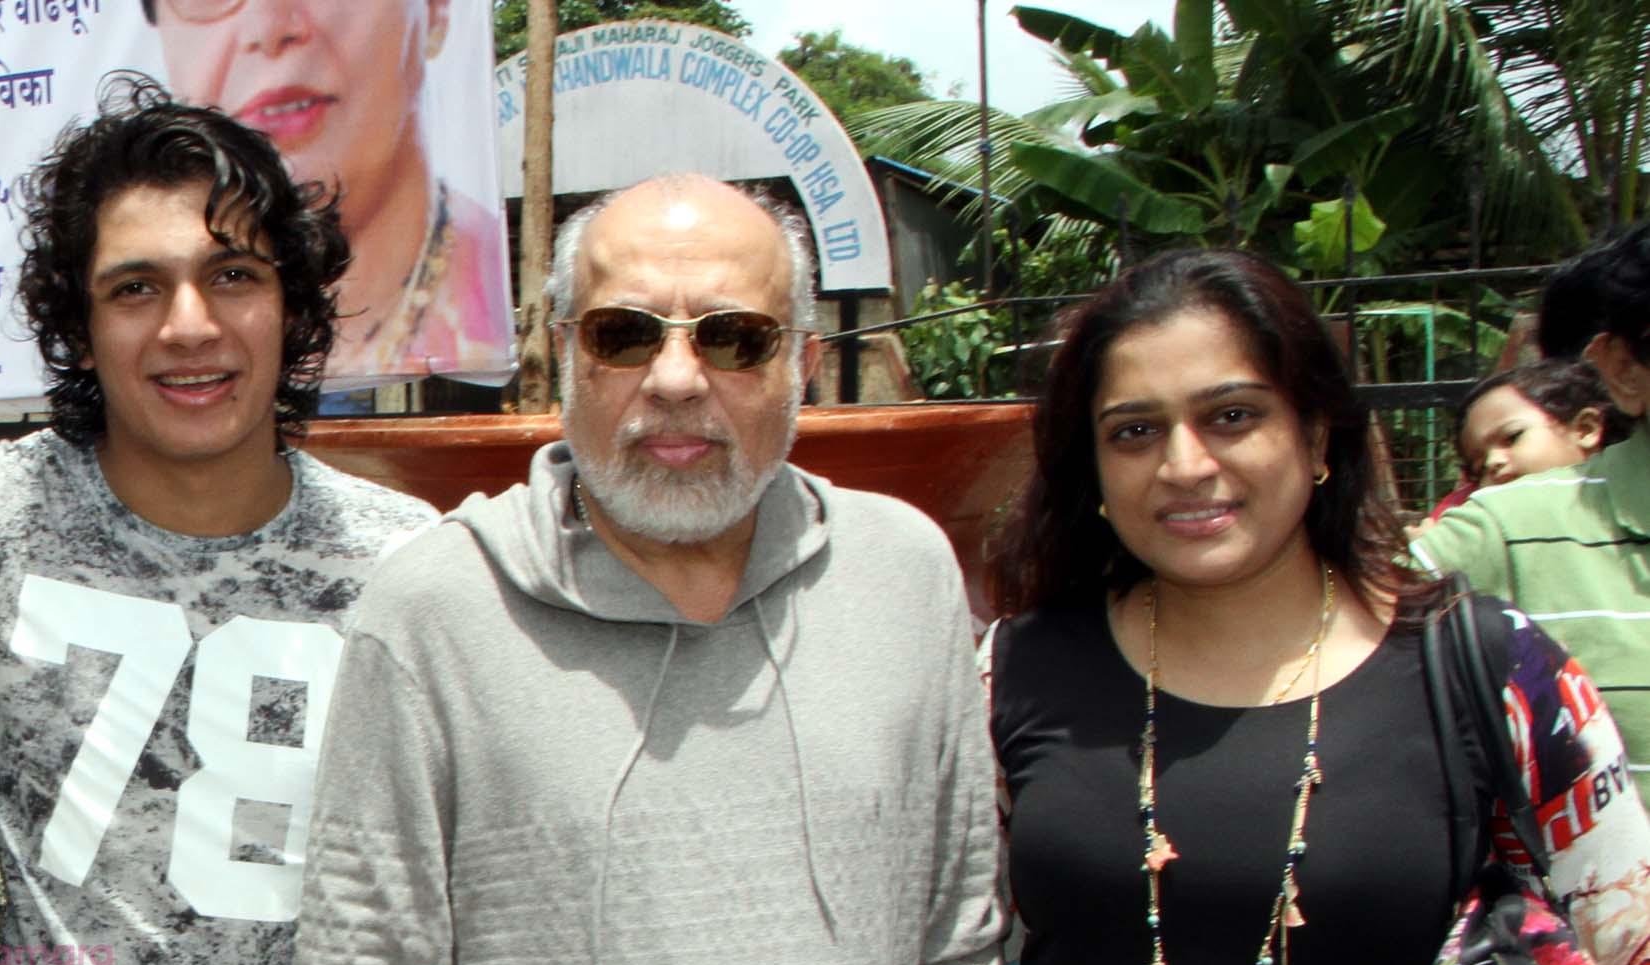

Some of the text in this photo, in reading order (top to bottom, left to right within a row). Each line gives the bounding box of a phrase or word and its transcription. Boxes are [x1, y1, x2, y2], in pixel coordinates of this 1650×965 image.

[592, 25, 681, 46] MAHARAJ
[689, 34, 768, 78] JOGGERS
[773, 76, 822, 126] PARK
[681, 51, 771, 122] COMPLEX
[10, 573, 345, 922] 78
